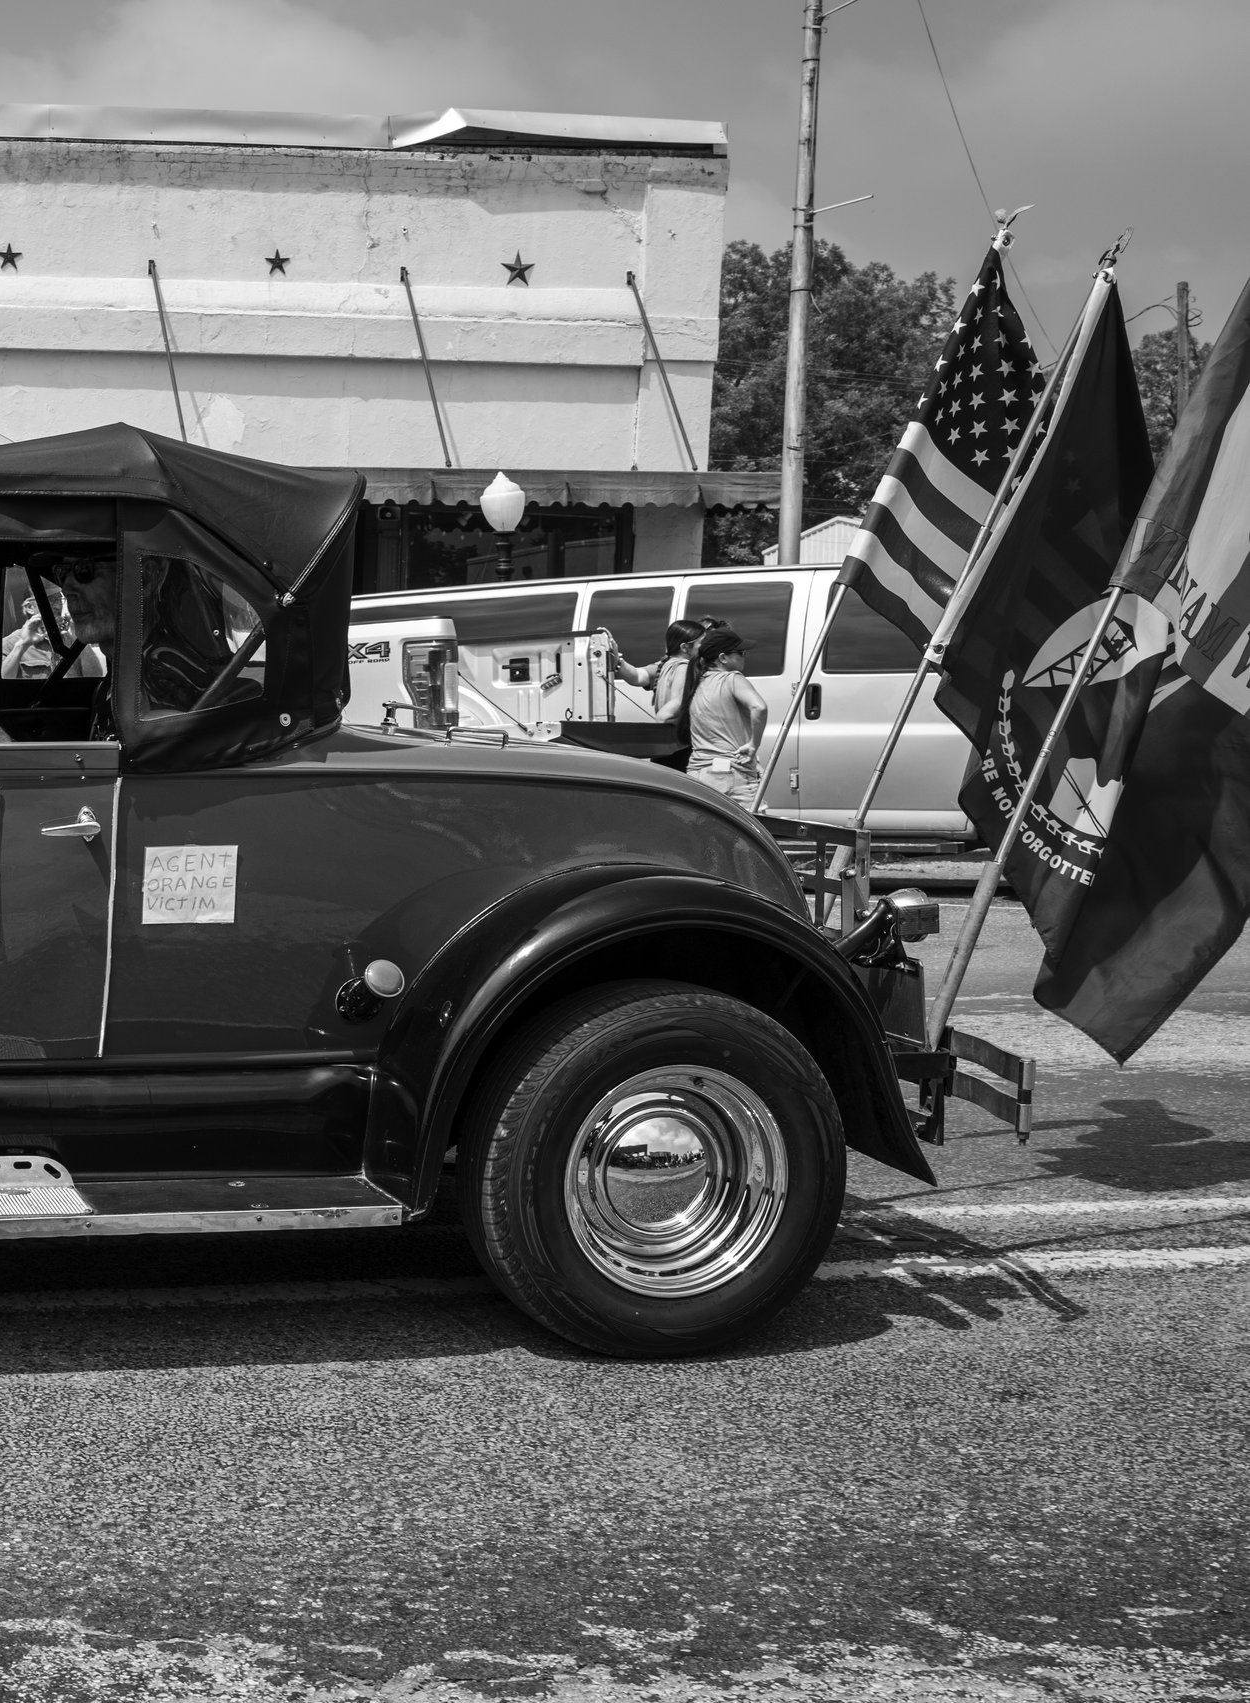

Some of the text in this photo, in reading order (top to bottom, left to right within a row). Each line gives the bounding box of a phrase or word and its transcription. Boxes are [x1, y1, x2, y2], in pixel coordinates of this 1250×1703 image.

[981, 749, 1000, 783] RE
[1018, 820, 1096, 887] FORGOTTE
[150, 851, 233, 873] AGENT
[147, 876, 234, 892] ORANGE
